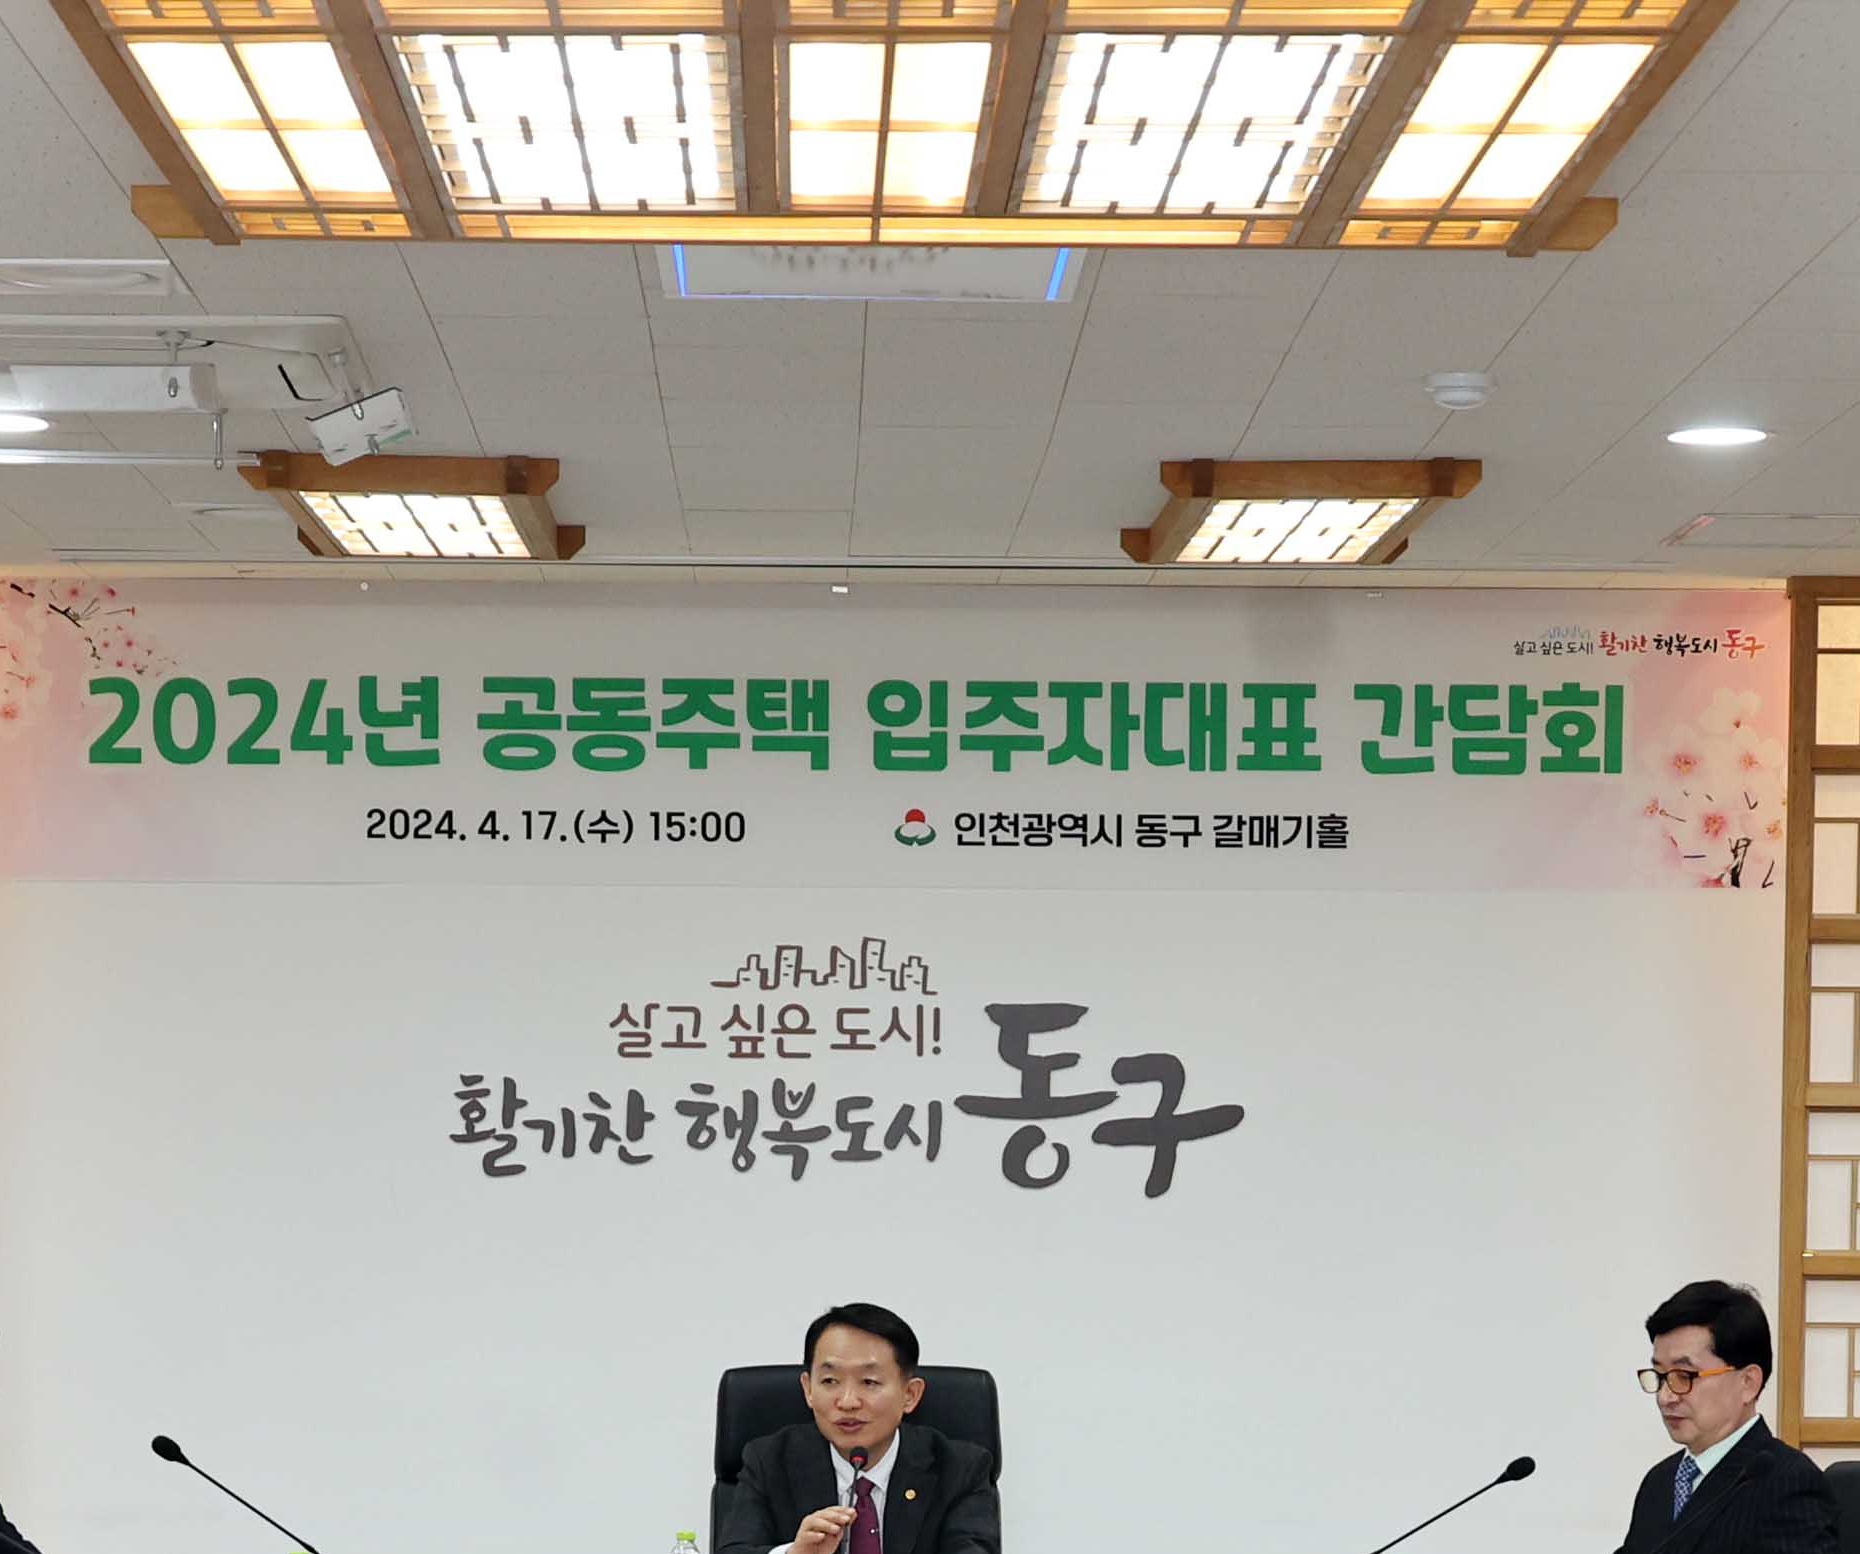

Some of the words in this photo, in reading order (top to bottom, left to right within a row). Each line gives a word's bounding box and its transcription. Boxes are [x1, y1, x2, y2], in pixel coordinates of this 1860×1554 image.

[1598, 631, 1648, 656] 활기찬
[1652, 633, 1718, 657] 행복도시
[1721, 629, 1766, 660] 동구
[88, 676, 441, 768] 2024년
[476, 676, 831, 773] 공동주택
[866, 680, 1323, 774] 입주자대표
[1354, 683, 1624, 776] 간담회
[365, 808, 468, 842] 2024.
[477, 810, 511, 842] 4.
[648, 811, 747, 843] 15:00
[953, 811, 1124, 848] 인천광역시
[1133, 813, 1204, 849] 동구
[1211, 813, 1351, 849] 갈매기홀
[608, 1002, 708, 1060] 살고
[720, 1003, 818, 1060] 싶은
[829, 1003, 943, 1059] 도시!
[449, 1073, 656, 1178] 활기찬
[673, 1078, 943, 1182] 행복도시
[953, 1002, 1246, 1200] 동구
